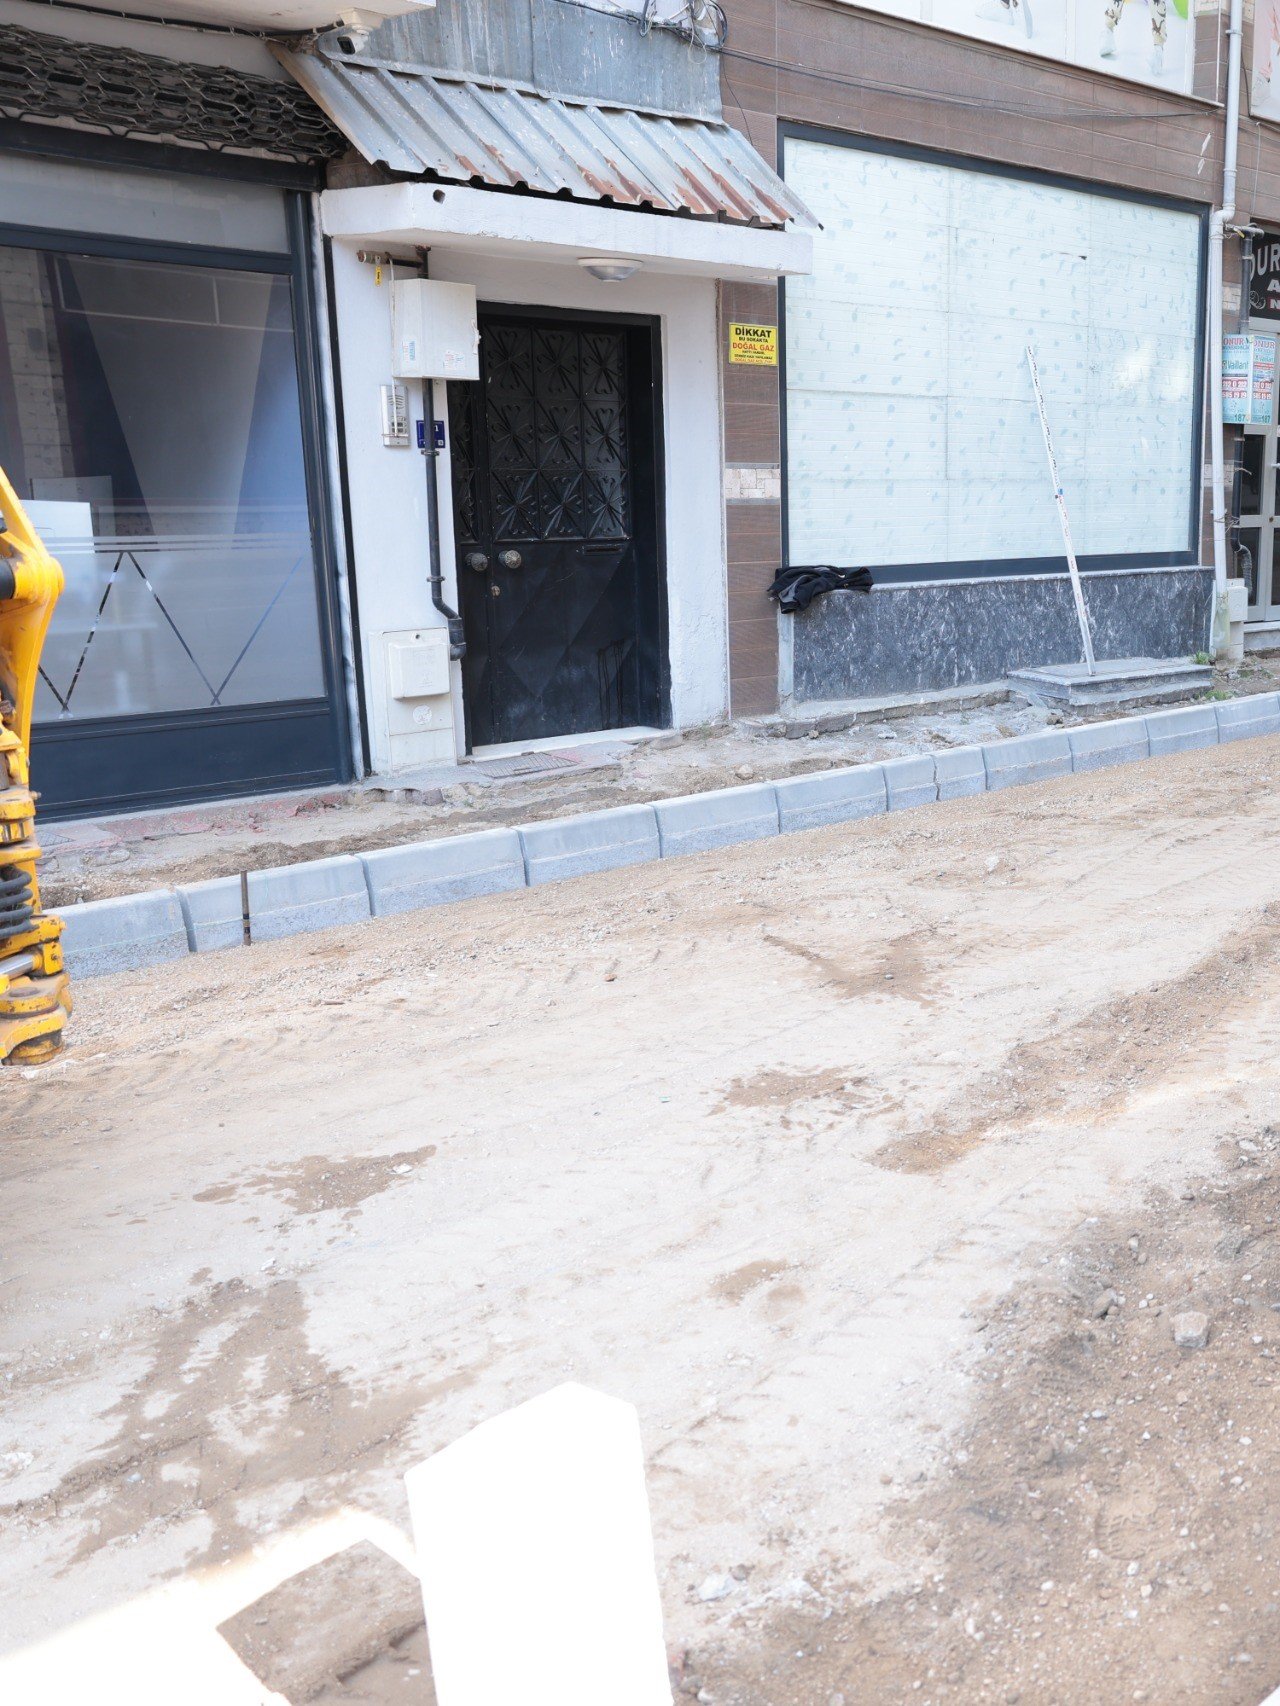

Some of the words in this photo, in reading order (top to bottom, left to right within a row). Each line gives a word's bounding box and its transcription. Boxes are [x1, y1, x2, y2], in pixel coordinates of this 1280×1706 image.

[735, 326, 771, 338] DİKKAT
[1223, 337, 1244, 346] ONUR
[732, 342, 757, 350] DOĞAL
[759, 344, 775, 352] GAZ
